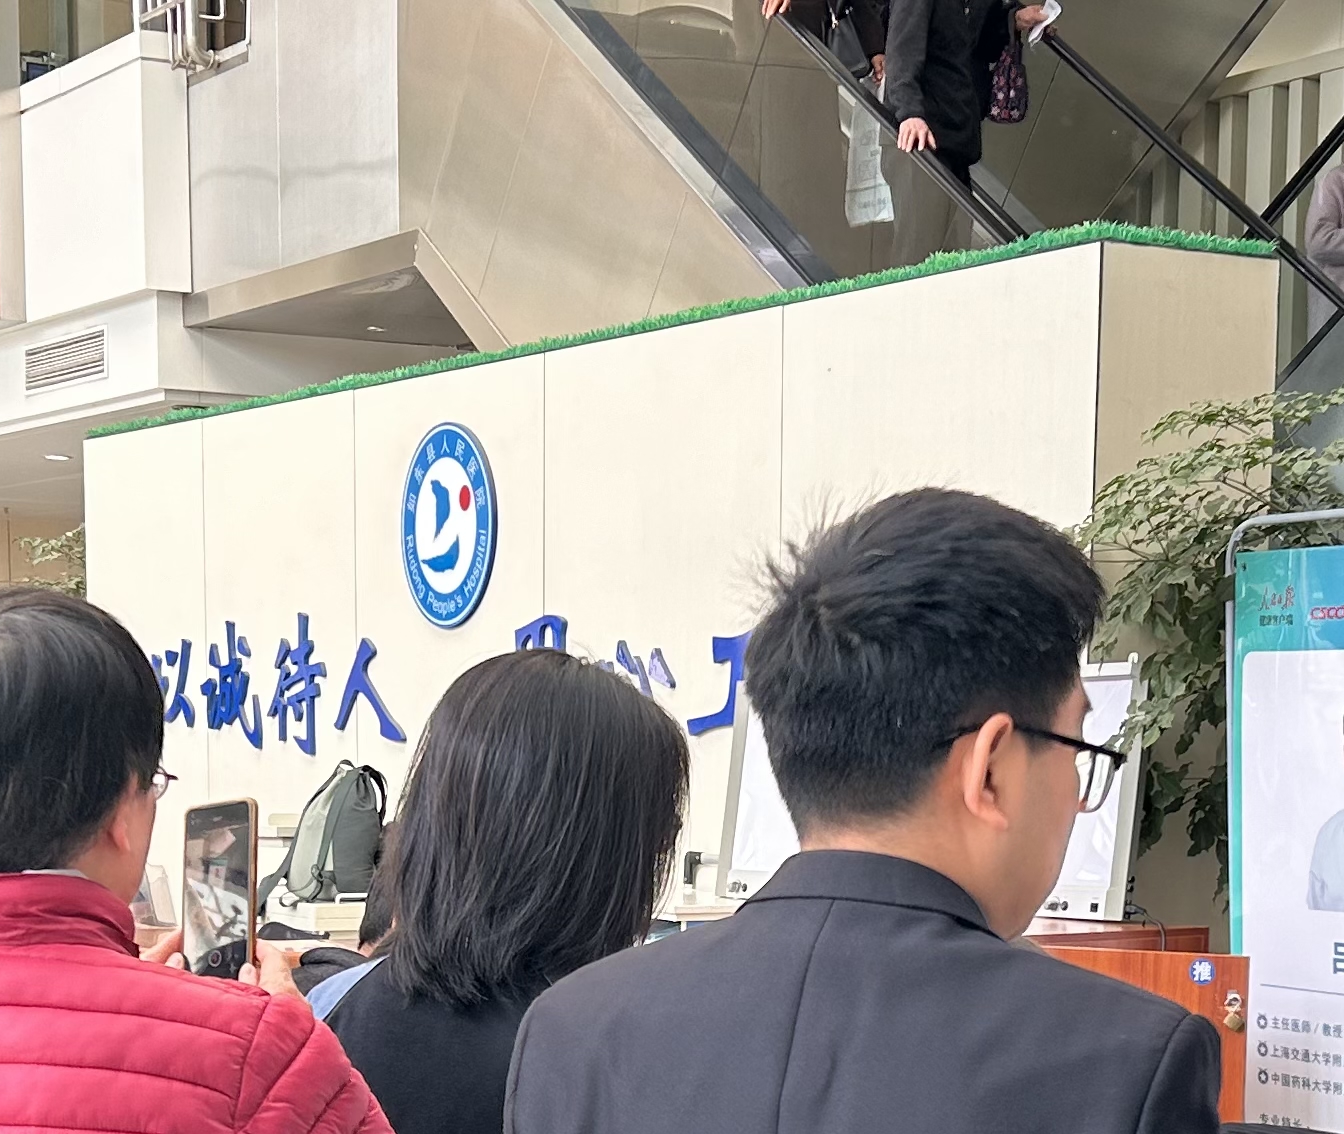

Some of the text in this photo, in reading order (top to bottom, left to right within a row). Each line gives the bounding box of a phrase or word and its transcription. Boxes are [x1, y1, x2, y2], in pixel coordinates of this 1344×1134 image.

[406, 434, 487, 515] 如东县人民医院
[406, 529, 488, 618] Rudong People's Hospital
[150, 612, 407, 757] 以诚待人
[1193, 962, 1212, 982] 推
